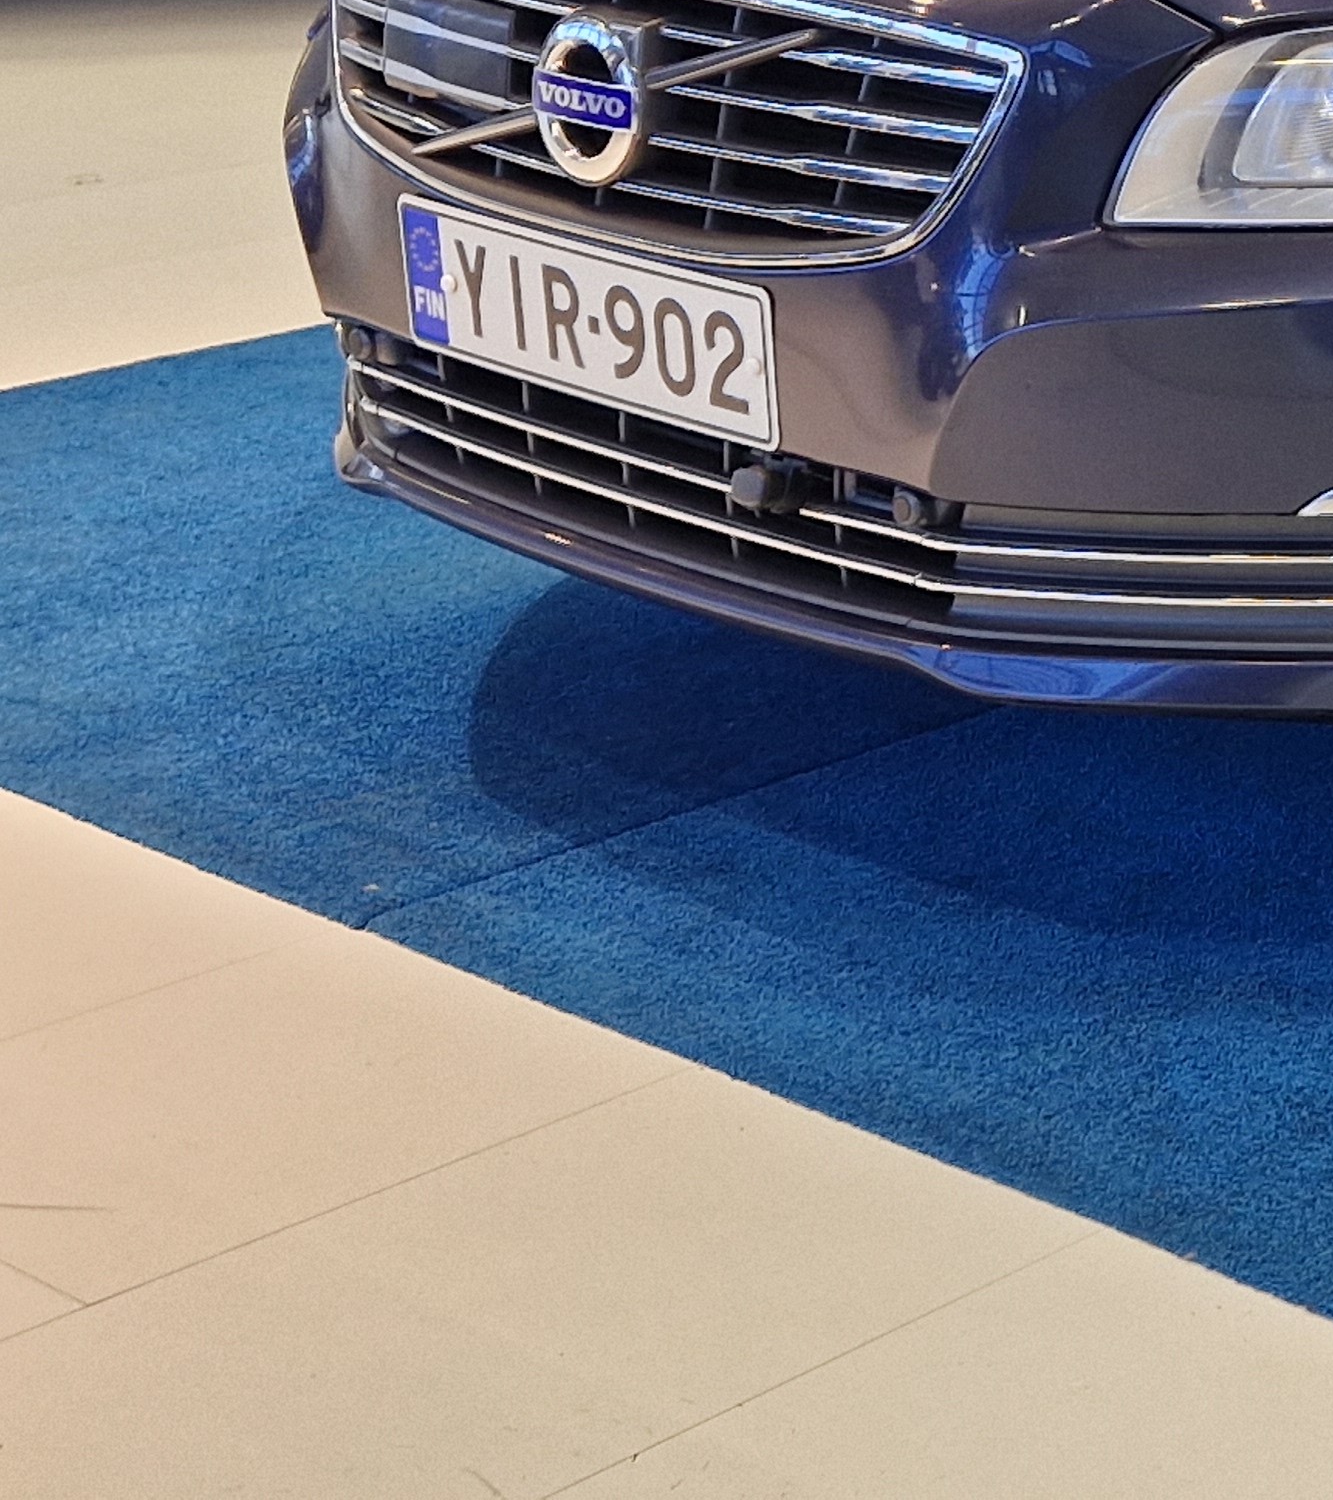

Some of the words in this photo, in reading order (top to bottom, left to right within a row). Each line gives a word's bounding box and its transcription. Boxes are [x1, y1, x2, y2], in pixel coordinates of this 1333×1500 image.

[537, 81, 627, 119] VOLVO
[413, 284, 447, 322] FIN
[454, 238, 750, 416] YIR-902
